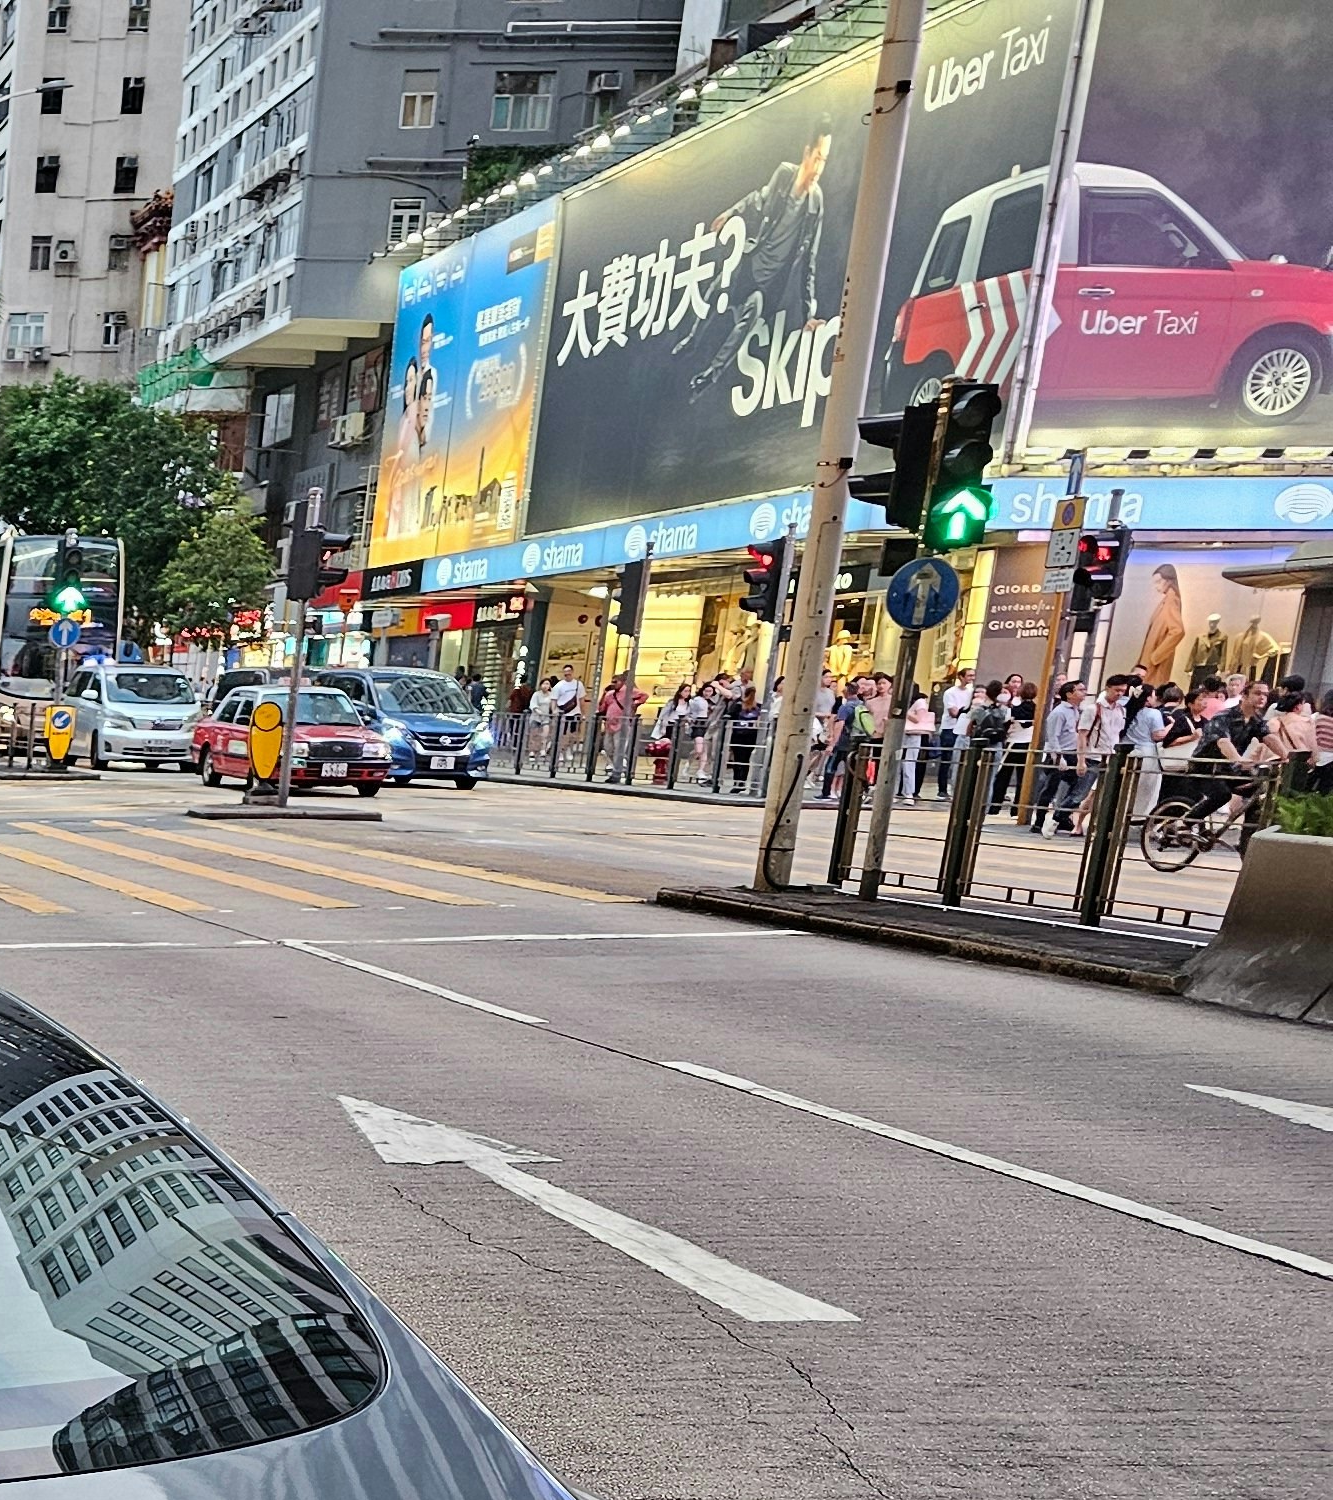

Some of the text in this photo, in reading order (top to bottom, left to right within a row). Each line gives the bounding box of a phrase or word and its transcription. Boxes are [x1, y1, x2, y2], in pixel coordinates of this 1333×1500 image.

[924, 15, 1052, 112] Uber Taxi
[557, 216, 746, 367] 大費功夫?
[1081, 309, 1200, 335] Uber Taxi
[779, 498, 812, 537] sha
[1010, 483, 1144, 524] shma
[649, 521, 698, 553] shama
[453, 556, 488, 583] shama
[542, 540, 583, 571] shama
[994, 584, 1042, 595] GIORD
[988, 619, 1046, 630] GIORDA
